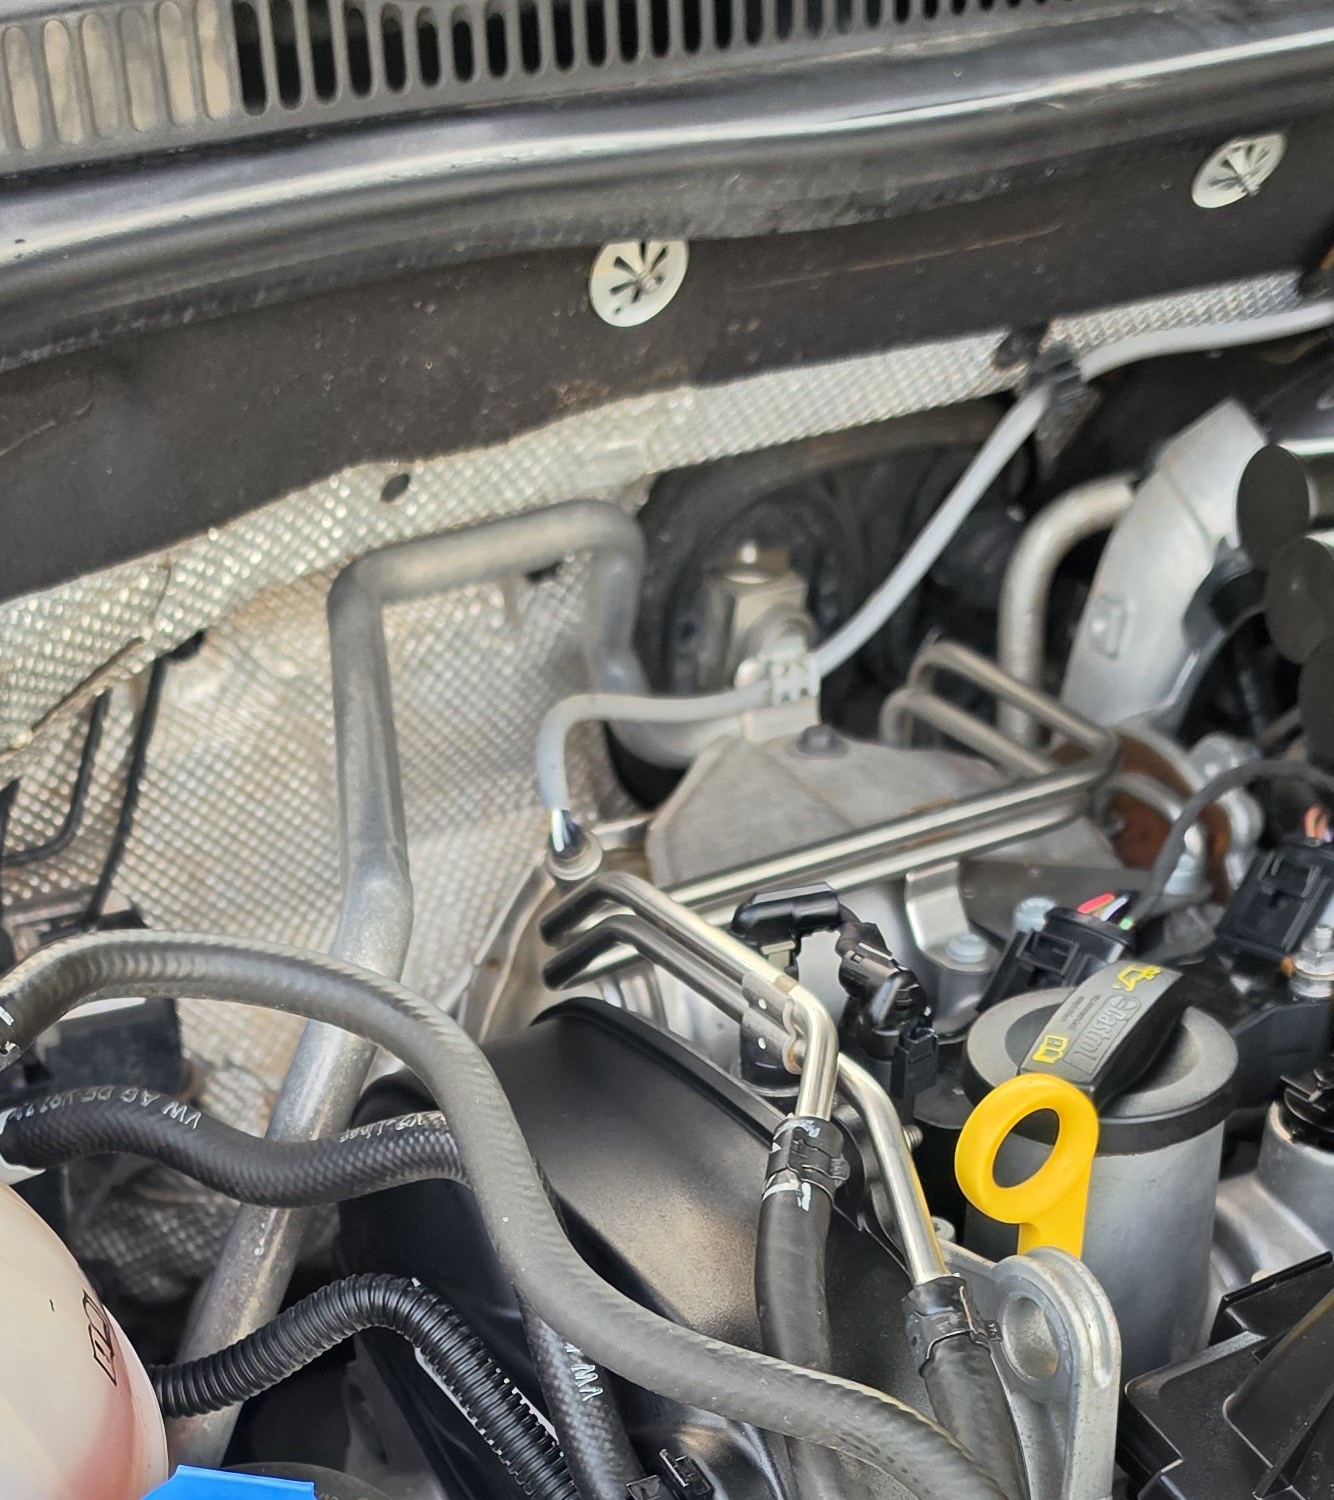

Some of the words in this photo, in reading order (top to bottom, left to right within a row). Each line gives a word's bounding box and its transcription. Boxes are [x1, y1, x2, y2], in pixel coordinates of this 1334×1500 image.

[1072, 995, 1140, 1061] Castrol
[162, 1102, 202, 1130] VW
[570, 1363, 604, 1402] VW
